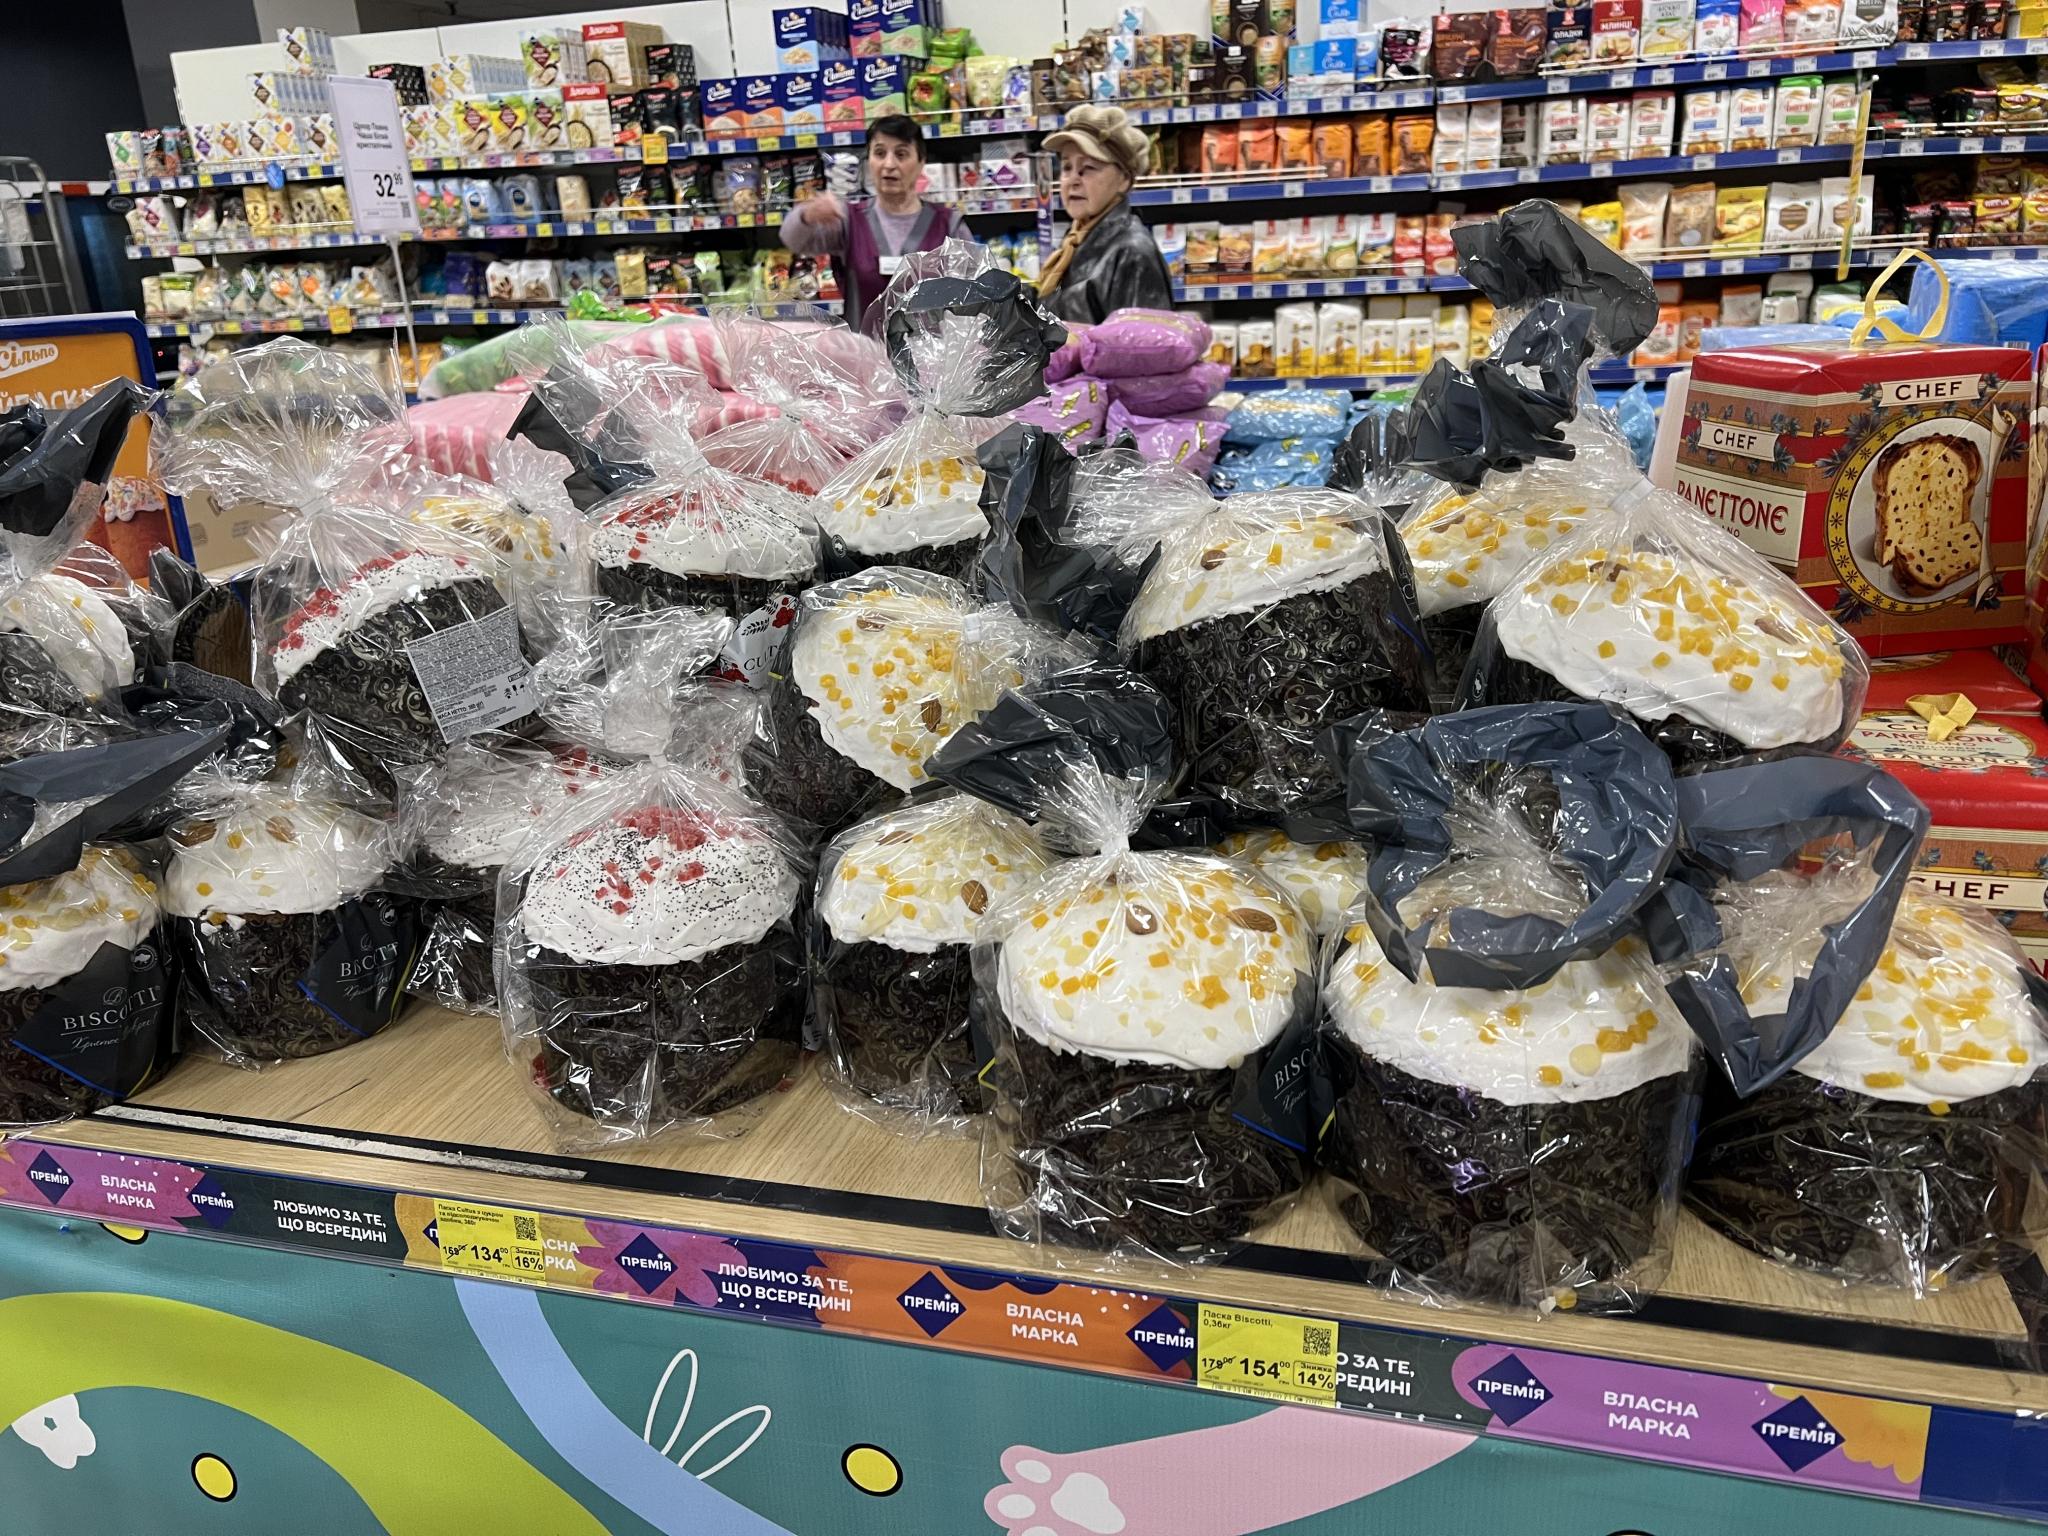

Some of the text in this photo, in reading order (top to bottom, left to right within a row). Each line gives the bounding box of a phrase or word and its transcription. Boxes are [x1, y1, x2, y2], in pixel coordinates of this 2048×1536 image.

[1601, 21, 1633, 31] МЛИНЦІ
[373, 174, 396, 197] 32
[1895, 381, 1962, 401] CHEF
[1713, 428, 1757, 450] CHEF
[1677, 480, 1789, 535] PANETTONE
[30, 1169, 70, 1185] ПРЕМІЯ
[101, 1174, 157, 1194] ВЛАСНА
[106, 1192, 156, 1210] МАРКА
[192, 1192, 234, 1209] ПРЕМІЯ
[438, 1204, 456, 1212] Паска
[273, 1200, 387, 1228] ЛЮБИМО ЗА ТЕ,
[277, 1216, 387, 1243] ЩО ВСЕРЕДИНІ
[471, 1244, 503, 1263] 134
[514, 1255, 544, 1271] 16%
[545, 1256, 577, 1272] РКА
[621, 1256, 672, 1272] ПРЕМІЯ
[718, 1263, 853, 1294] ЛЮБИМО ЗА ТЕ,
[721, 1281, 851, 1312] ЩО ВСЕРЕДИНІ
[904, 1294, 960, 1314] ПРЕМІЯ
[1006, 1302, 1084, 1328] ВЛАСНА
[1203, 1309, 1273, 1328] Паска Biscotti,
[1203, 1319, 1232, 1329] 0,36кг
[1011, 1323, 1079, 1346] МАРКА
[1134, 1329, 1195, 1350] ПРЕМІЯ
[1240, 1357, 1281, 1380] 154
[1300, 1363, 1333, 1373] Знижка
[1353, 1357, 1380, 1371] ЗА
[1384, 1359, 1415, 1378] ТЕ,
[1298, 1371, 1334, 1390] 14%
[1336, 1372, 1411, 1397] РЕДИНІ
[1477, 1380, 1545, 1401] ПРЕМІЯ
[1603, 1391, 1699, 1419] ВЛАСНА
[1608, 1412, 1691, 1440] МАРКА
[1761, 1423, 1836, 1446] ПРЕМІЯ
